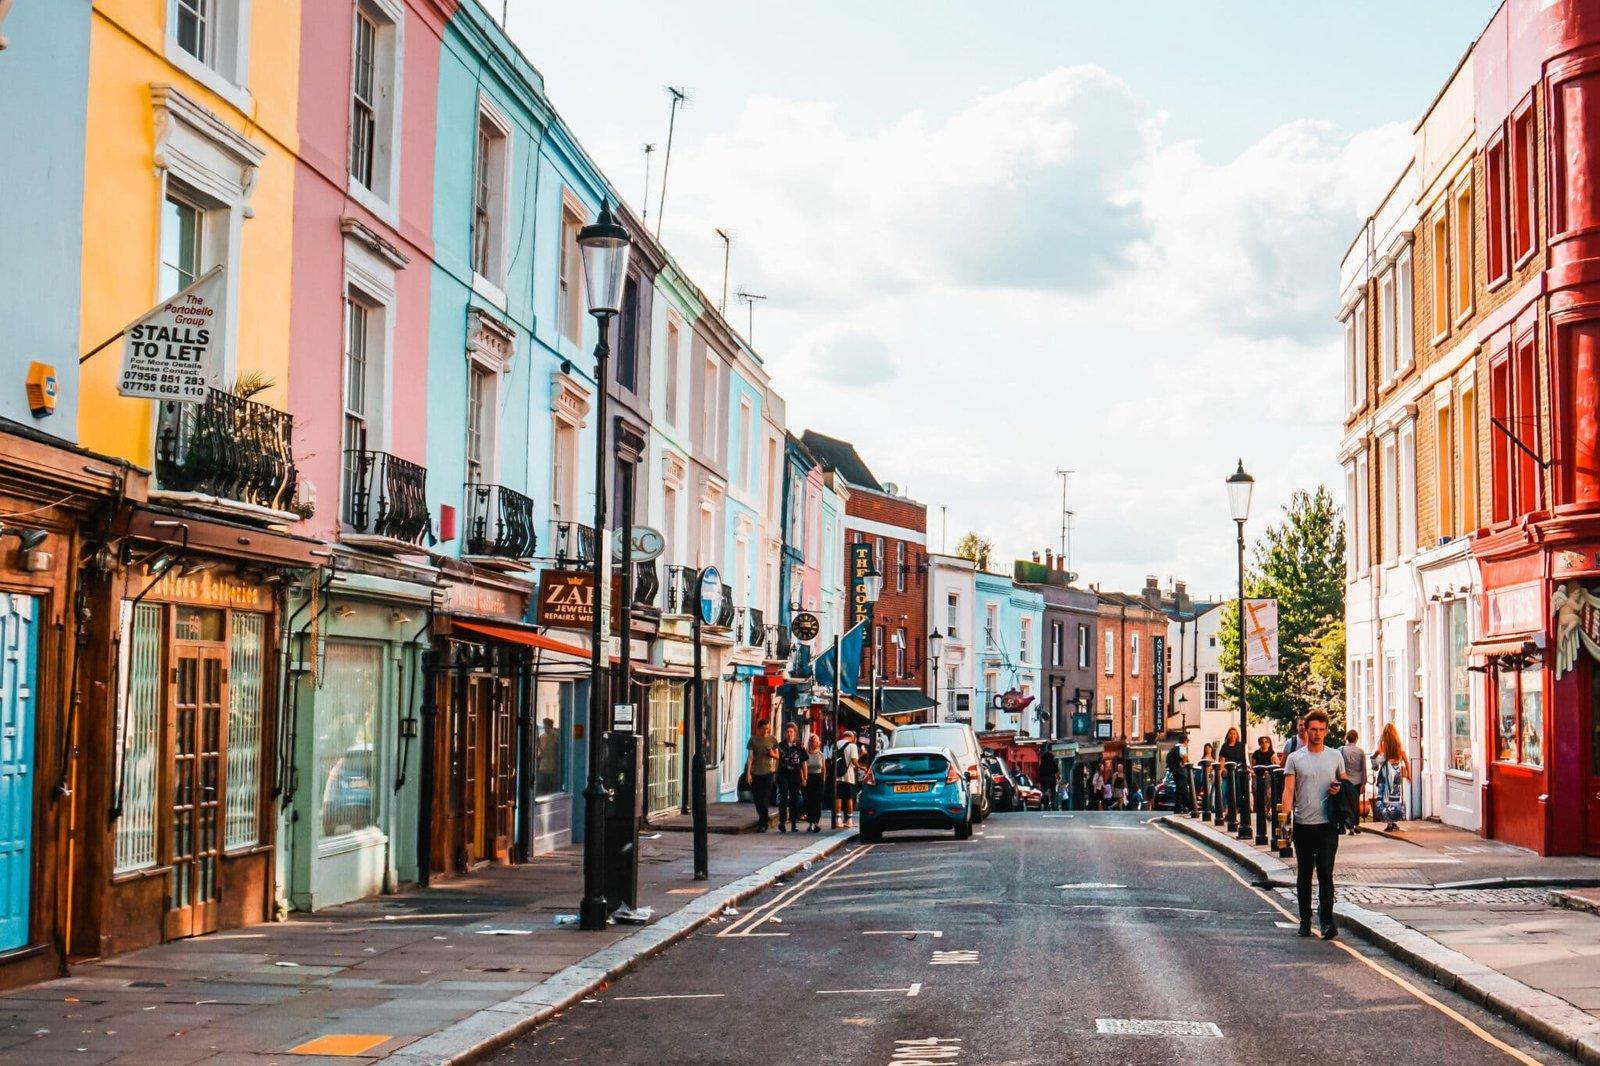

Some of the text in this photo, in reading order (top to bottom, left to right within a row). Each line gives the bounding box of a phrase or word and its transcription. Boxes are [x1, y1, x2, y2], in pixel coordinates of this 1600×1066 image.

[186, 294, 203, 305] The
[164, 303, 214, 317] Portobello
[175, 314, 205, 327] Group
[131, 324, 209, 345] STALLS
[131, 341, 206, 362] TO LET
[131, 363, 160, 372] Please
[147, 359, 169, 367] More
[172, 361, 202, 369] Details
[124, 371, 204, 386] 07956 851 283
[122, 381, 204, 396] 07795 662 110
[856, 549, 868, 577] THE
[544, 613, 575, 621] REPAIRS
